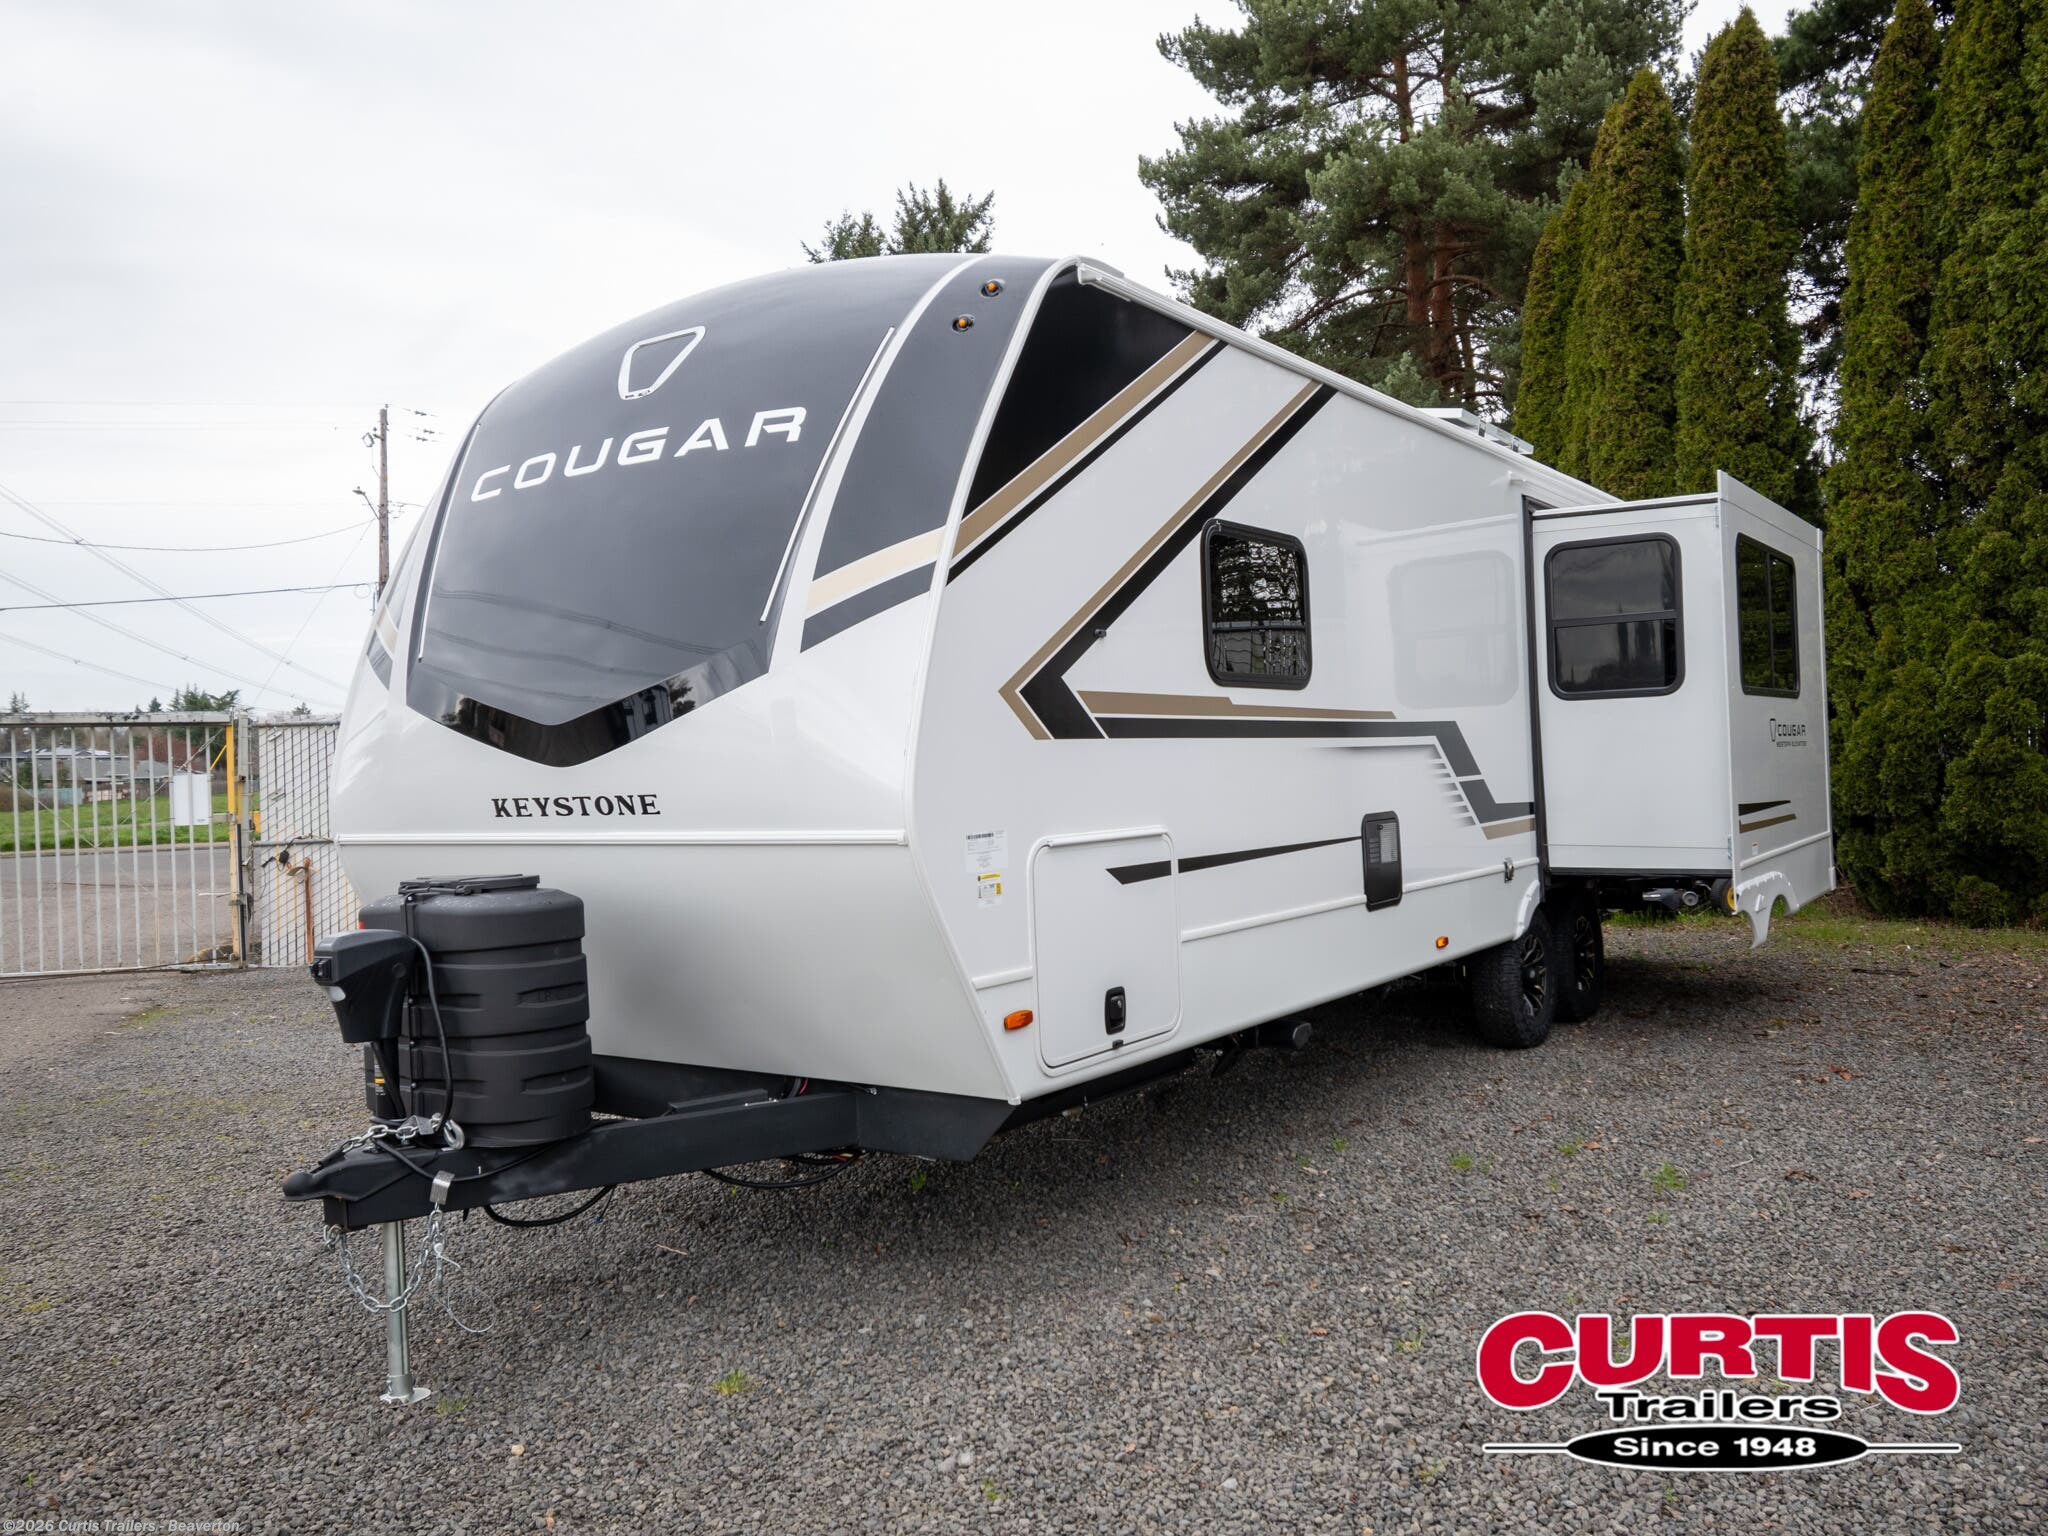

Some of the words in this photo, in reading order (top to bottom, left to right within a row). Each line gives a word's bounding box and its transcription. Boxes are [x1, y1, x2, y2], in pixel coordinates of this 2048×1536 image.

[470, 406, 807, 503] COUGAR
[1777, 724, 1807, 737] COUGAR
[492, 793, 662, 818] KEYSTONE
